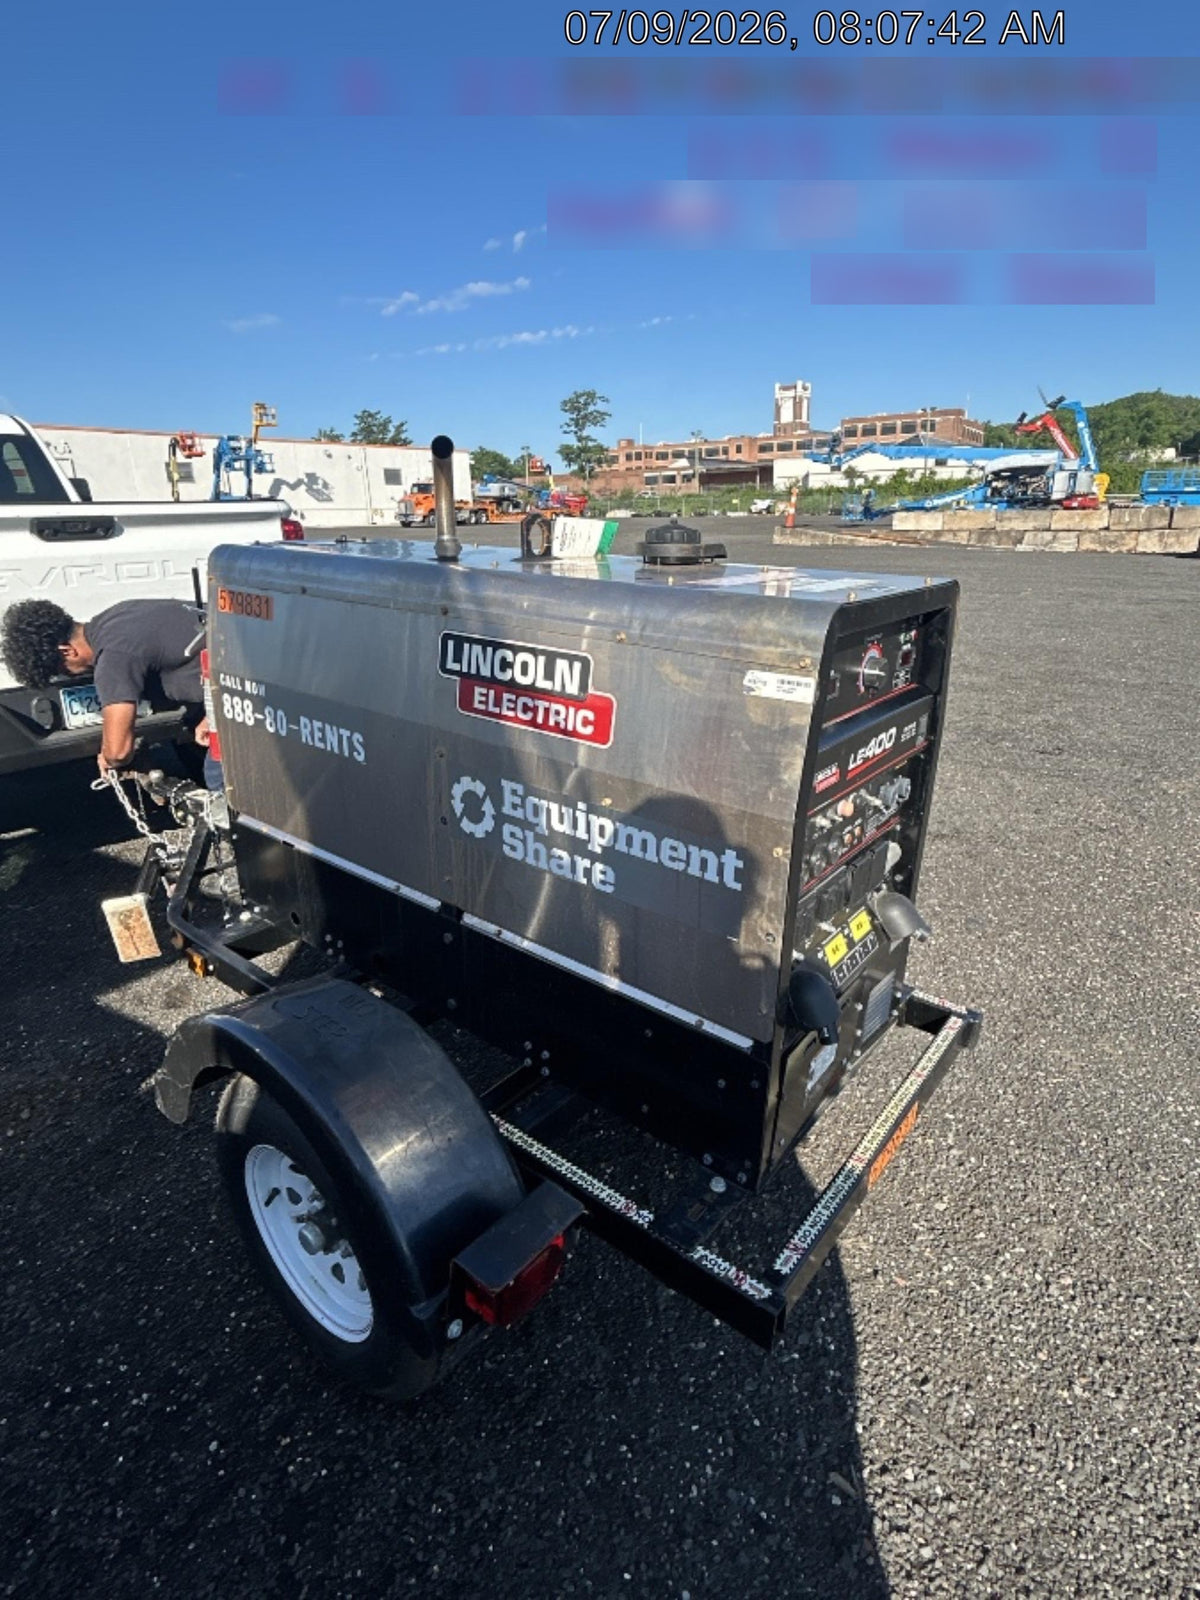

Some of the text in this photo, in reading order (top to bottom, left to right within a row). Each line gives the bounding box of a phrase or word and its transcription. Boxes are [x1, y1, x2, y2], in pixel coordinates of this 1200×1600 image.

[219, 589, 270, 619] 579831
[219, 673, 243, 690] CALL
[445, 640, 582, 696] LINCOLN
[221, 693, 366, 762] 888-80-RENTS
[473, 686, 595, 735] ELECTRIC
[847, 726, 897, 771] LE400
[501, 779, 744, 892] Equipment
[502, 823, 616, 893] Share
